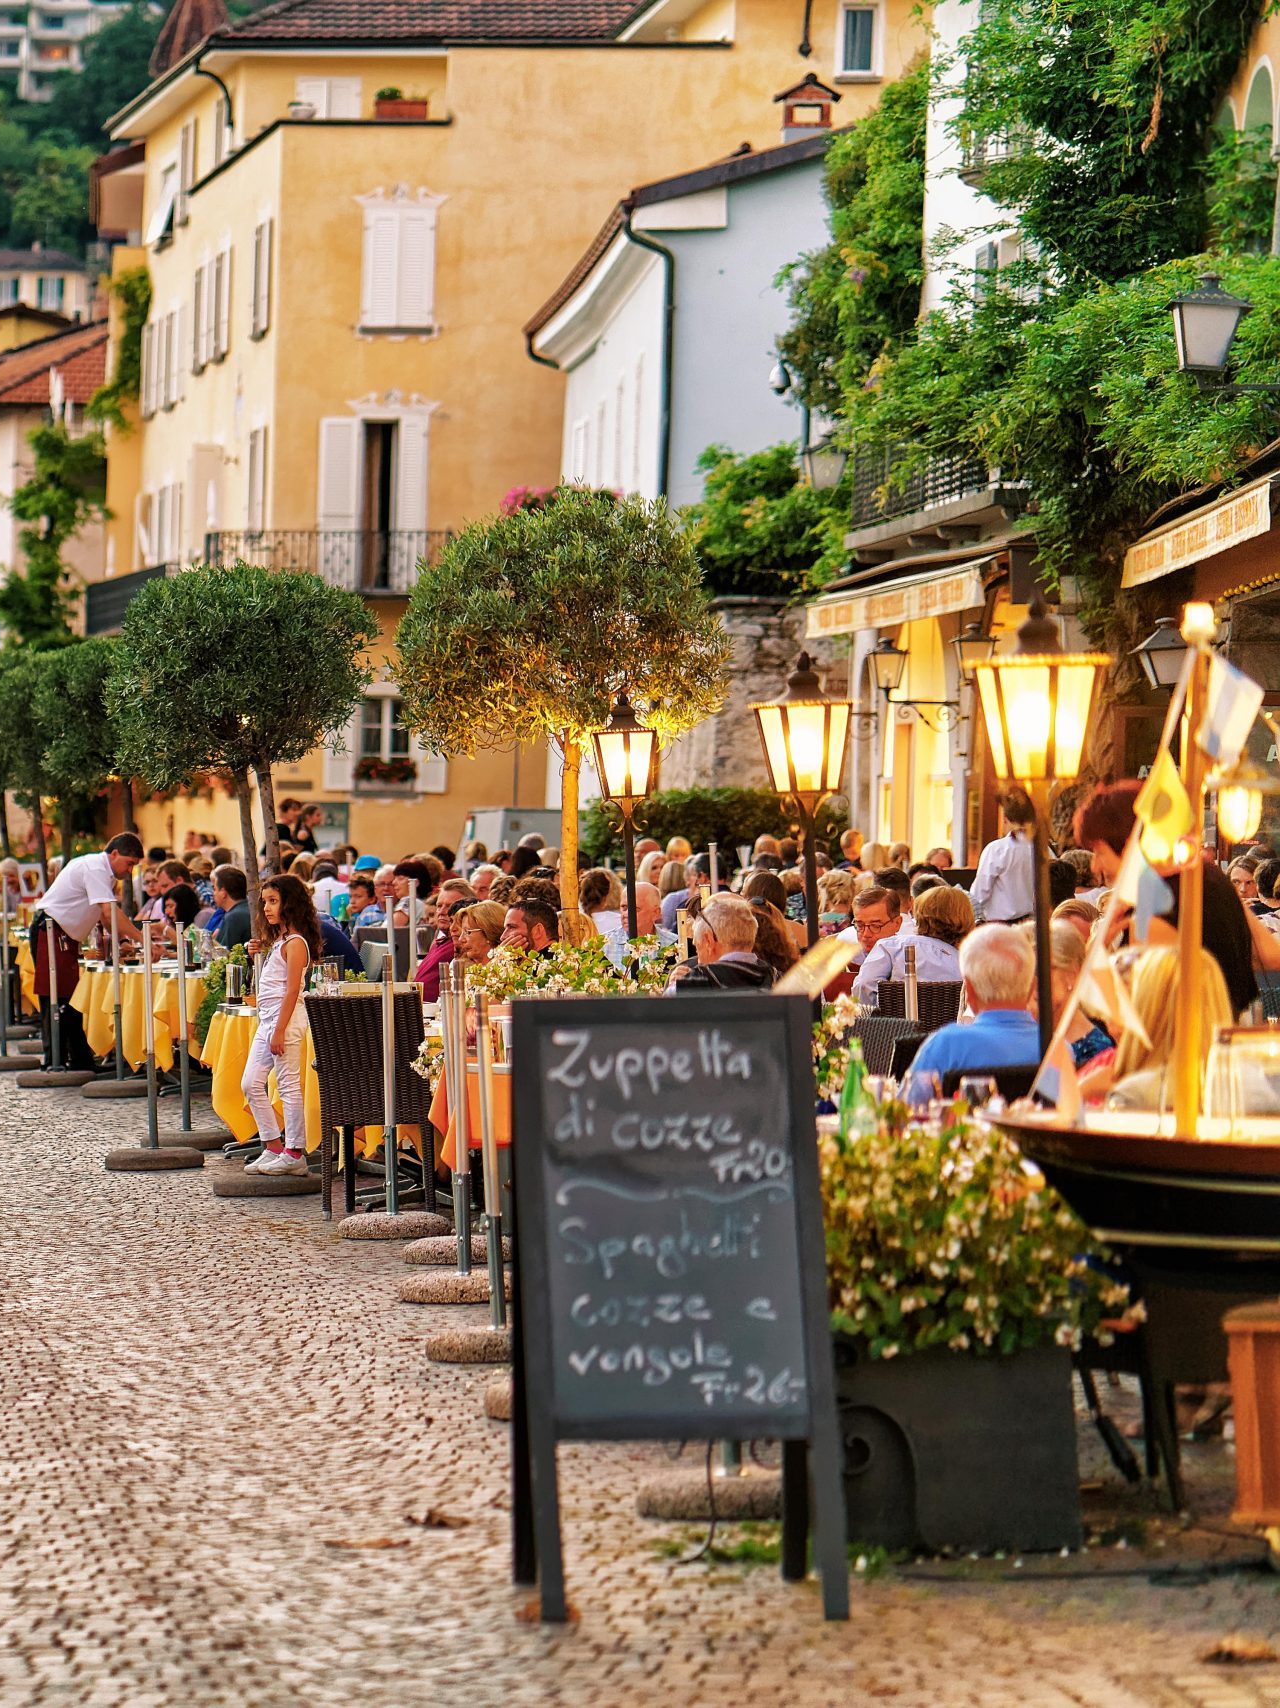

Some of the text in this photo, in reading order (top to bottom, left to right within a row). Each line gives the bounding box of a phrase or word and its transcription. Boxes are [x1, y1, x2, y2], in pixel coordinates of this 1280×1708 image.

[547, 1028, 751, 1100] Zuppetta
[554, 1093, 595, 1141] di
[746, 1296, 777, 1321] e
